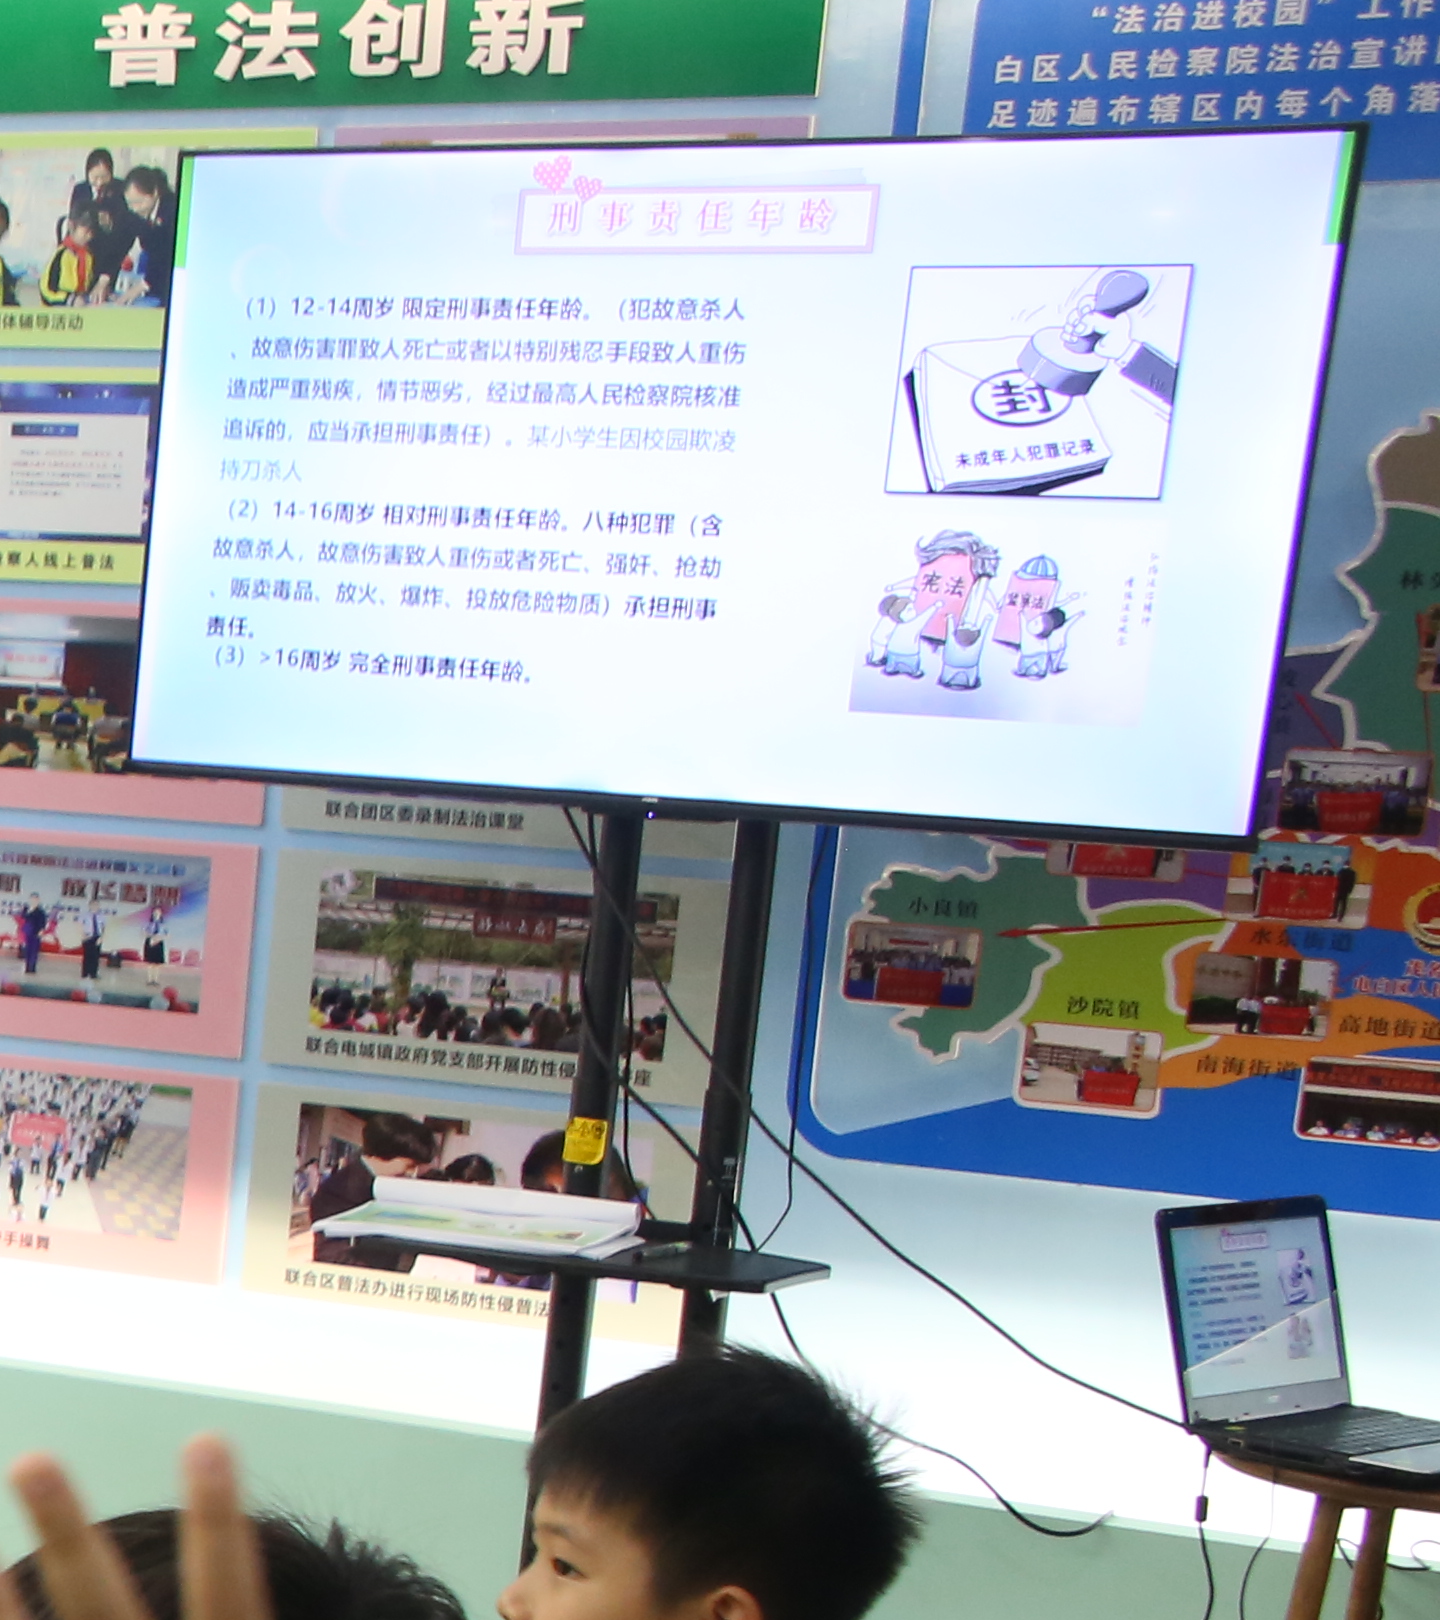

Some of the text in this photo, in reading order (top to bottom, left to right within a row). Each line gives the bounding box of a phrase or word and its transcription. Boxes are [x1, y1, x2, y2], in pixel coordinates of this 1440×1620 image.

[94, 0, 584, 87] 普法创新
[987, 80, 1440, 129] 足迹遍布辖区内每个角落
[547, 196, 837, 235] 刑事责任年龄
[955, 439, 1096, 470] 未成年人犯罪记录
[920, 569, 966, 598] 宪法
[325, 800, 524, 831] 联合团区委录制法治课堂
[1066, 995, 1141, 1020] 沙院镇
[305, 1036, 651, 1088] 联合电城镇政府党支部开展防性侵座
